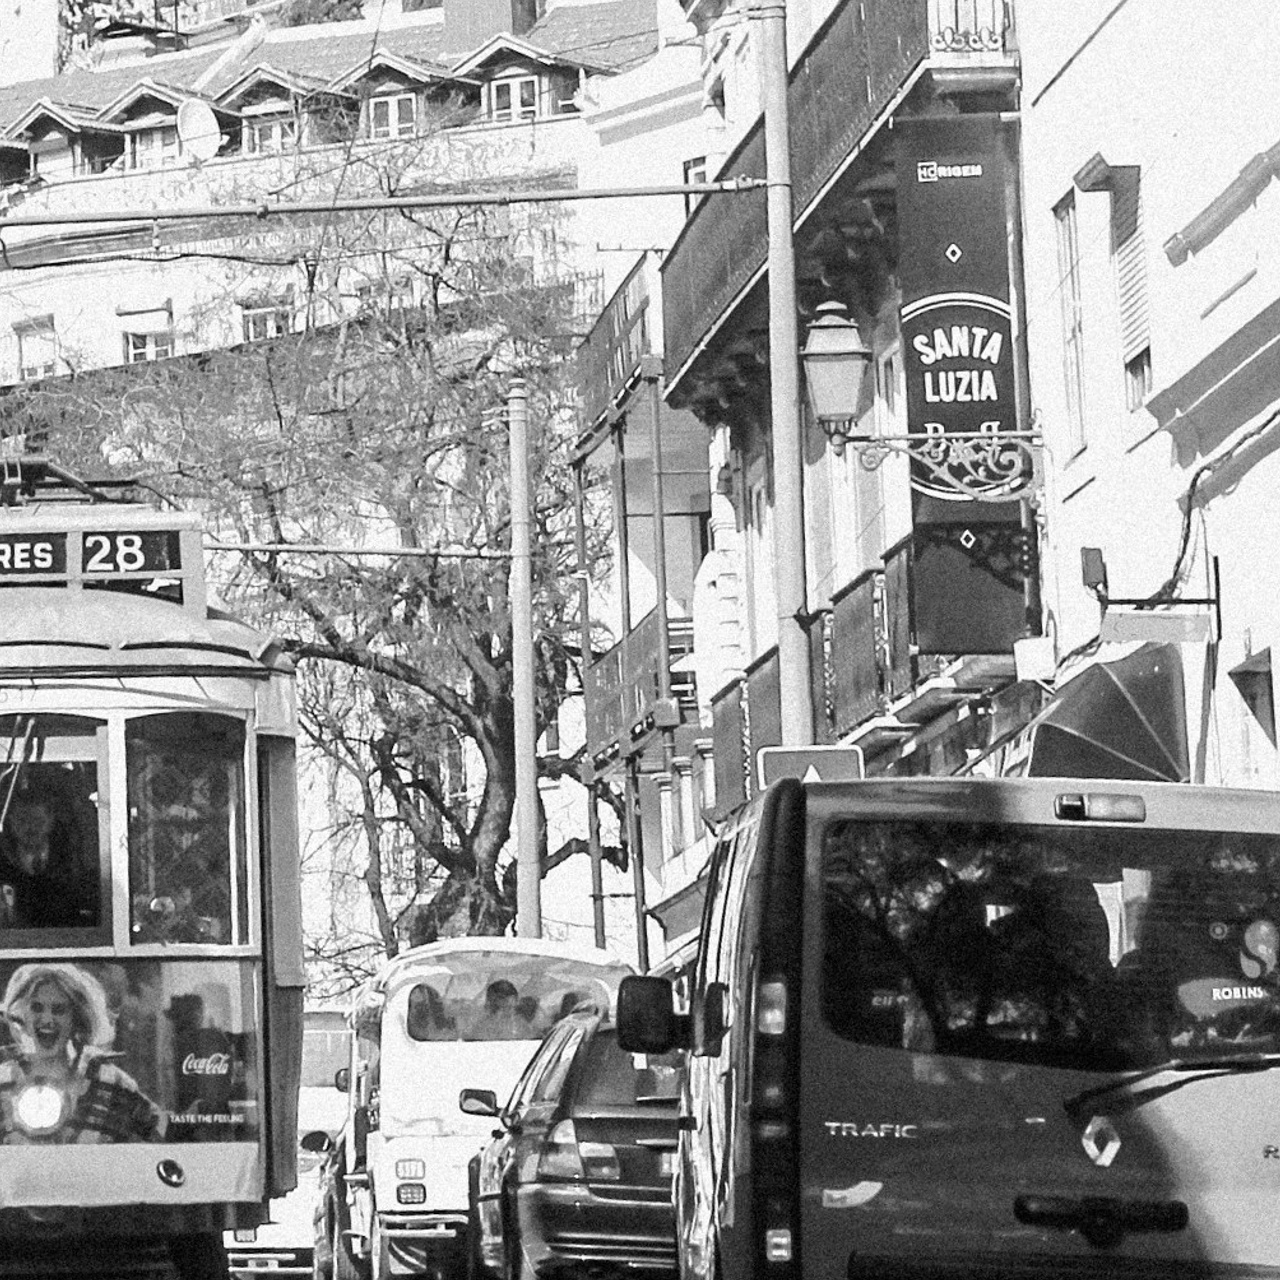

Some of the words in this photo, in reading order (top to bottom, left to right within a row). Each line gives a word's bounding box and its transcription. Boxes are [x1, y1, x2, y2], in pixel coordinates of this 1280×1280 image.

[913, 325, 1003, 365] SANTA
[924, 369, 998, 402] LUZIA
[85, 534, 146, 572] 28
[198, 1114, 212, 1124] THE
[824, 1122, 918, 1138] TRAFIC
